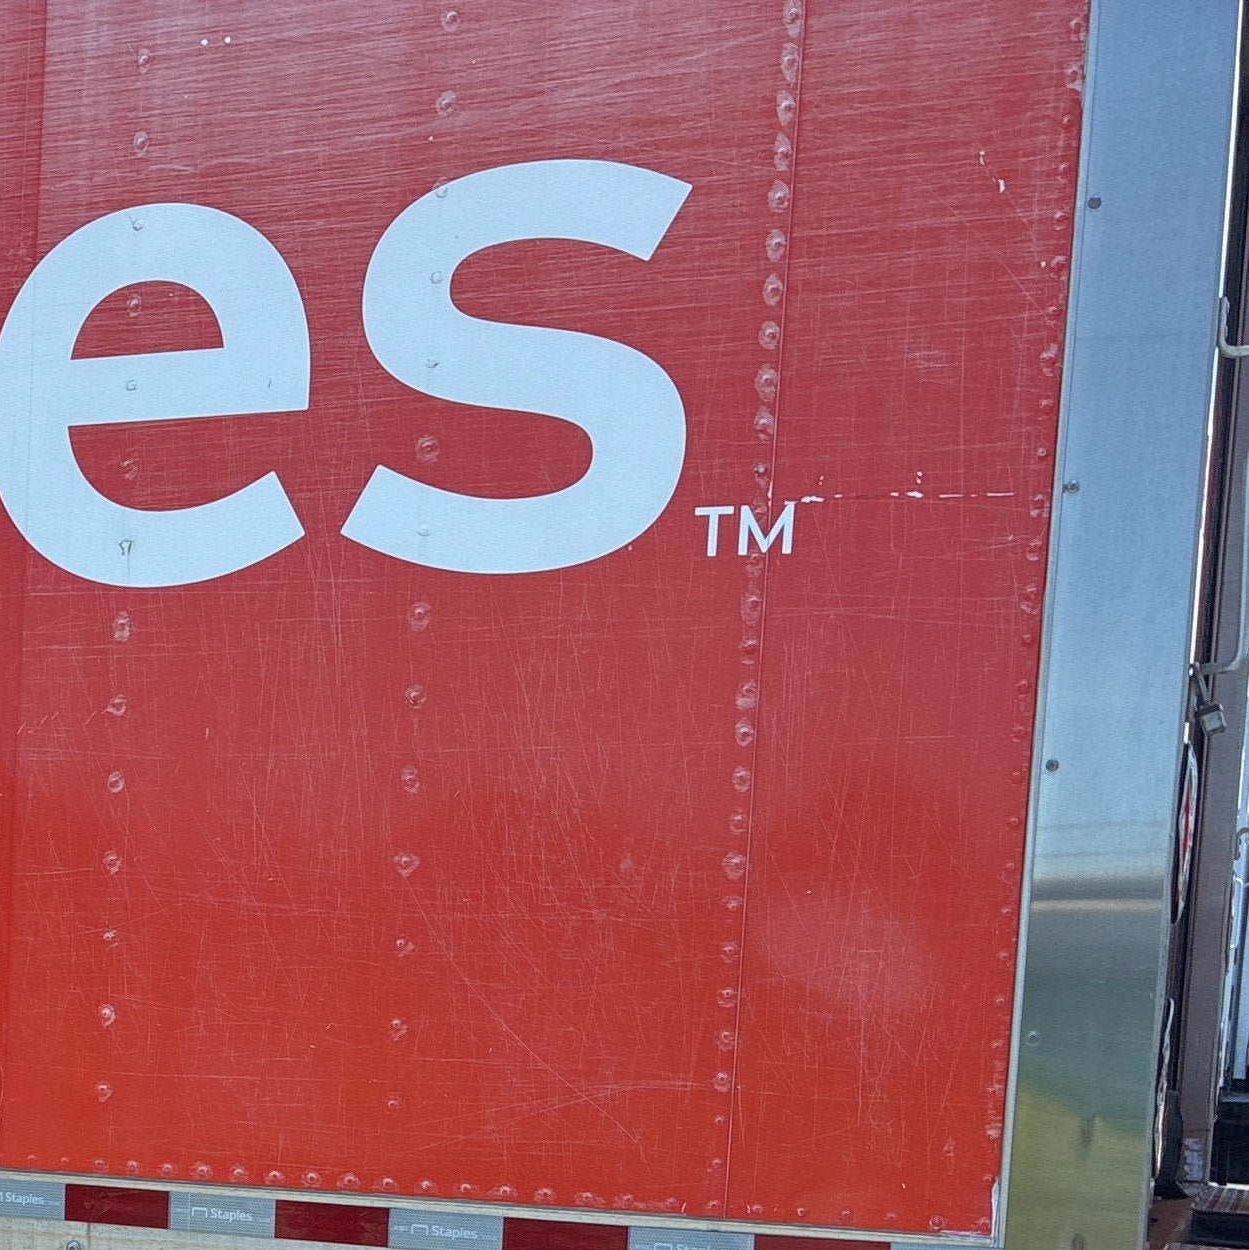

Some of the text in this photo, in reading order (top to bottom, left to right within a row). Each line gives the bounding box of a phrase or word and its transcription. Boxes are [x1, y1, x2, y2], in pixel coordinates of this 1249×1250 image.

[694, 501, 796, 557] TM
[5, 1192, 44, 1206] Staples
[210, 1208, 252, 1222] Staples
[431, 1225, 478, 1240] Staples
